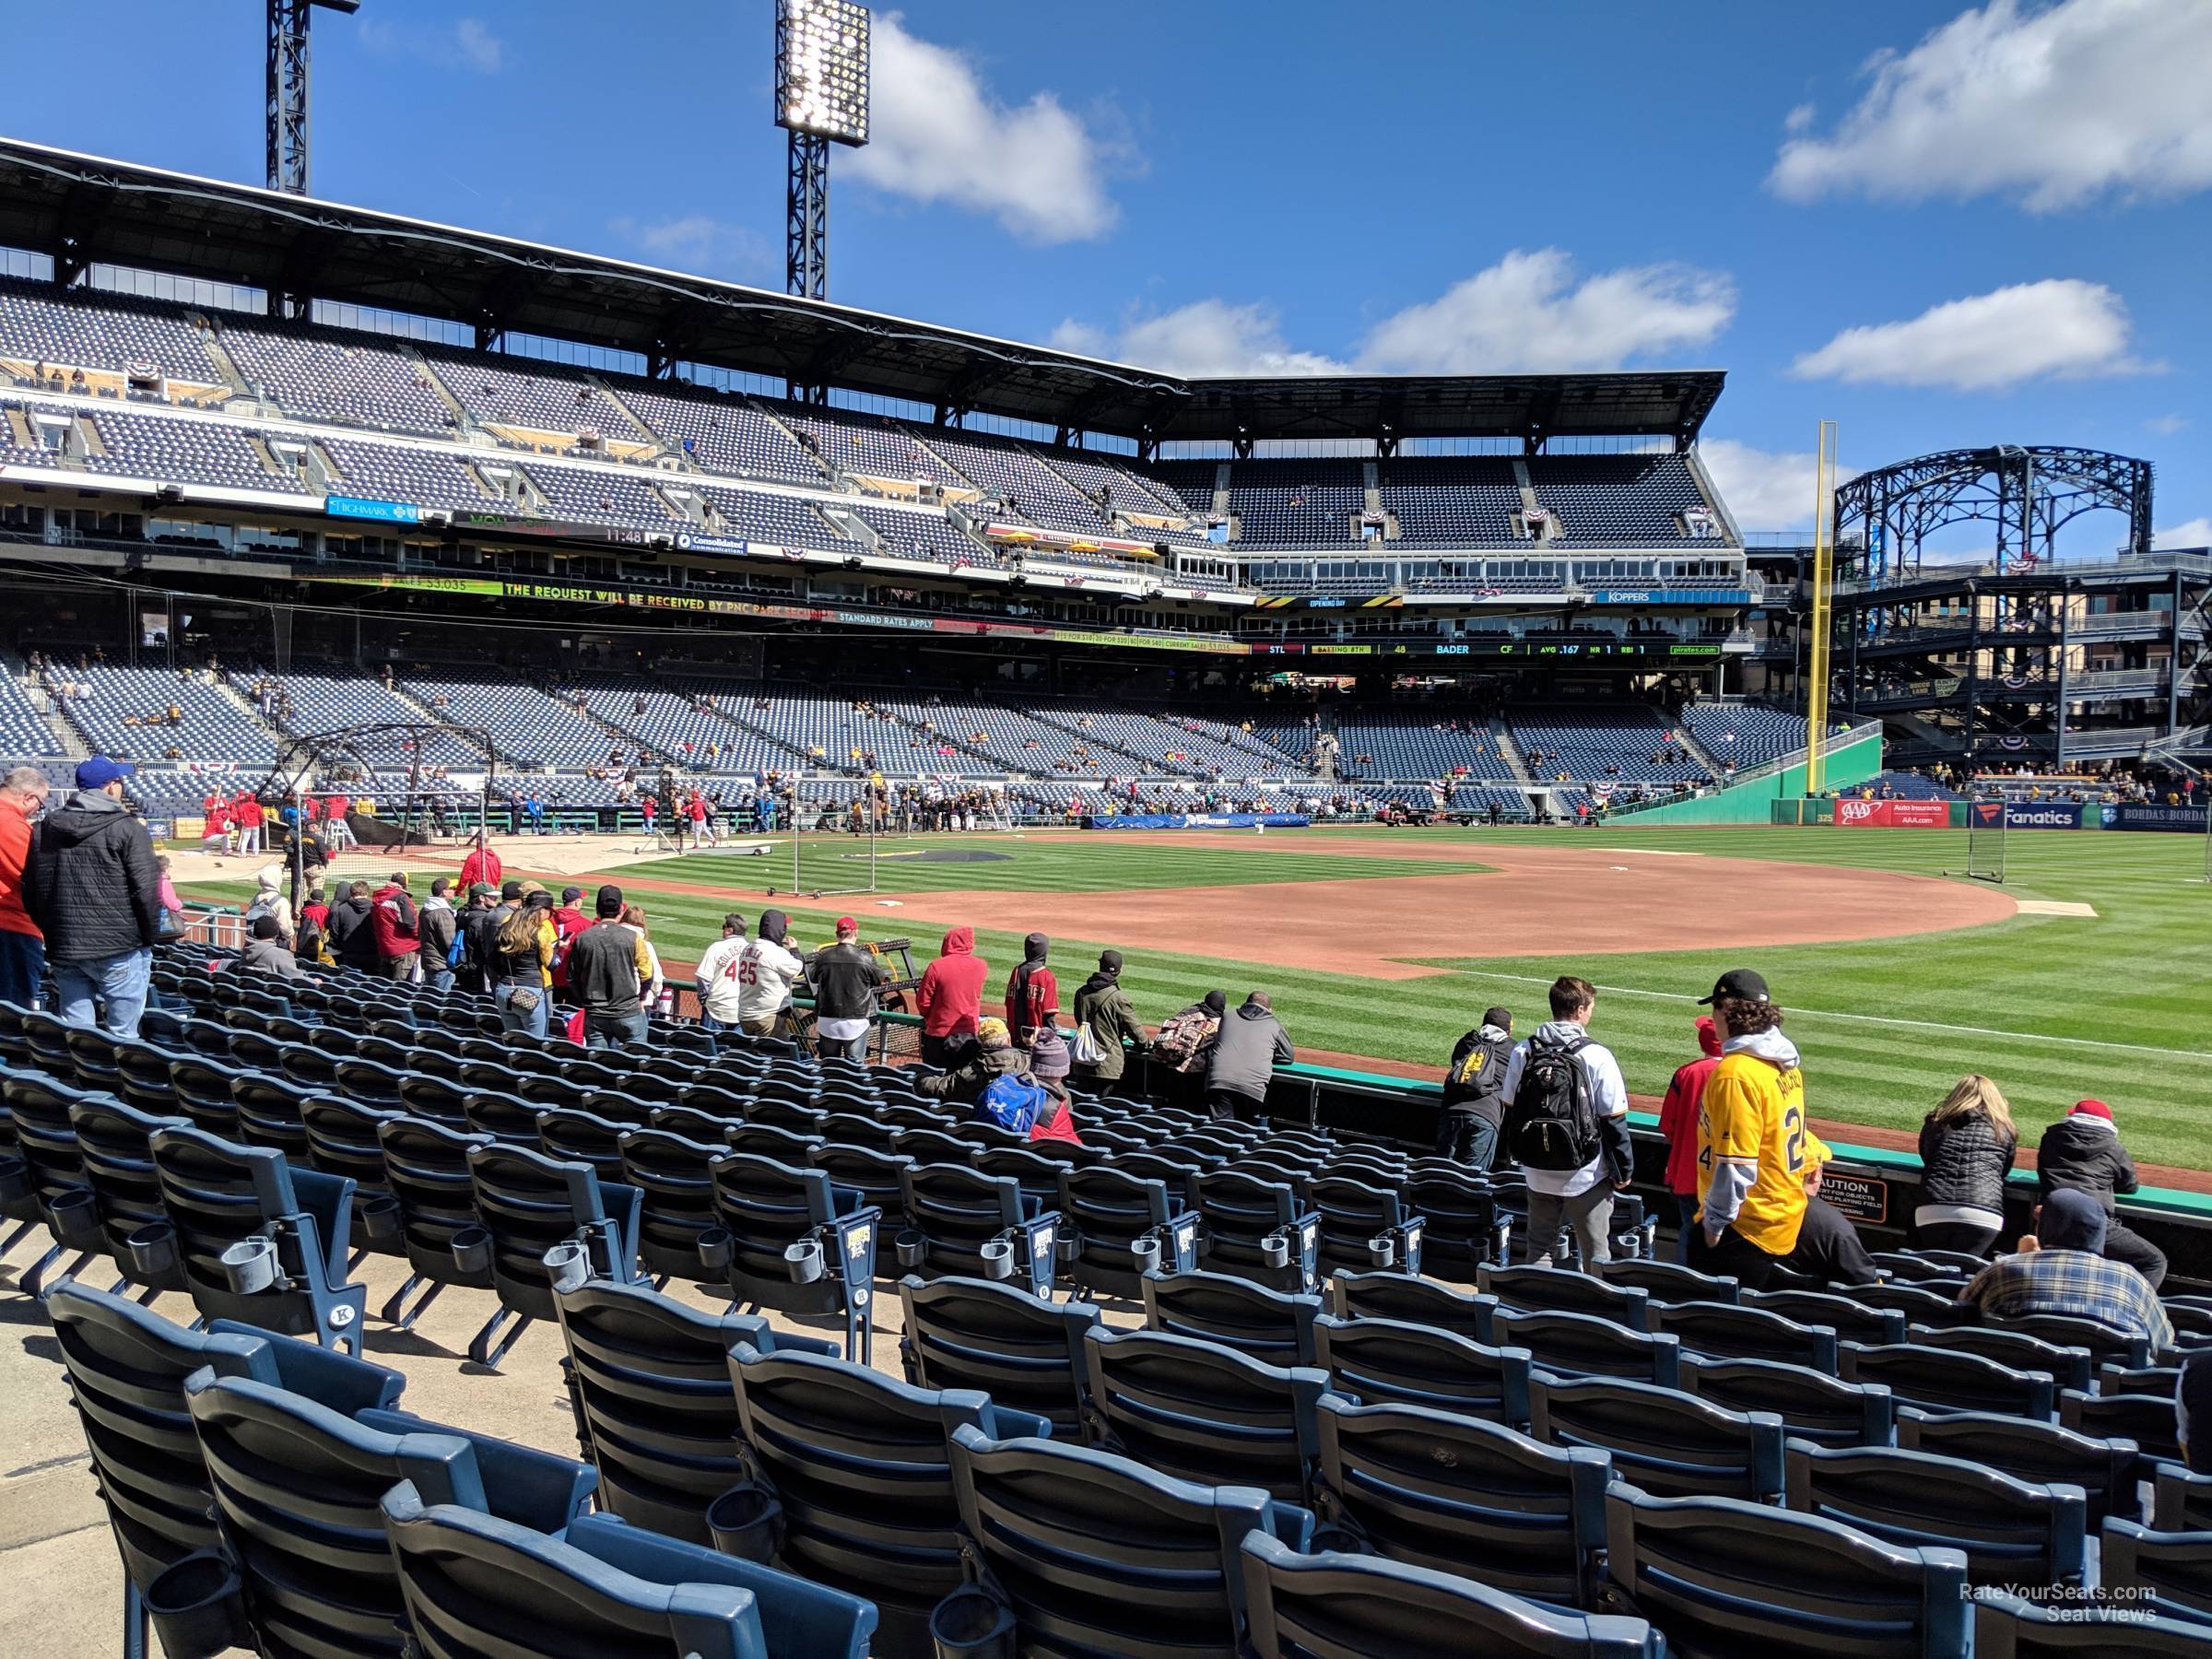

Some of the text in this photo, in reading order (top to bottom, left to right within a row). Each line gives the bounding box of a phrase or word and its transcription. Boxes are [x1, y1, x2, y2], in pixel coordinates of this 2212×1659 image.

[335, 500, 389, 517] HIGHMARK
[469, 514, 507, 525] MON
[606, 528, 641, 543] 11:48
[692, 535, 745, 548] Consolidated
[692, 544, 745, 554] communications
[505, 582, 531, 596] THE
[535, 585, 592, 601] REQUEST
[595, 590, 625, 605] WILL
[628, 594, 643, 606] BE
[647, 595, 705, 610] RECEIVED
[708, 600, 724, 611] BY
[726, 603, 750, 614] PNC
[1607, 592, 1650, 603] KOPPERS
[840, 612, 934, 629] STANDARD RATES APPLY
[1269, 645, 1286, 654] STL
[1394, 646, 1406, 654] 48
[1436, 645, 1469, 654] BADER
[1500, 645, 1513, 654] CF
[1540, 645, 1579, 654] AVG .167
[1589, 645, 1611, 654] HR 1
[1621, 645, 1645, 654] RBI 1
[1673, 646, 1717, 654] pirates.com
[1842, 805, 1869, 817] AAA
[2124, 808, 2166, 820] BORDAS
[1818, 814, 1833, 822] 325
[2006, 809, 2073, 825] Fanatics
[738, 959, 758, 986] 25
[1699, 1144, 1712, 1171] 4
[1820, 1179, 1869, 1194] AUTION
[1845, 1192, 1876, 1201] OBJECTS
[1834, 1196, 1862, 1206] PLAYING
[1863, 1201, 1883, 1209] FIELD
[335, 1308, 350, 1323] K
